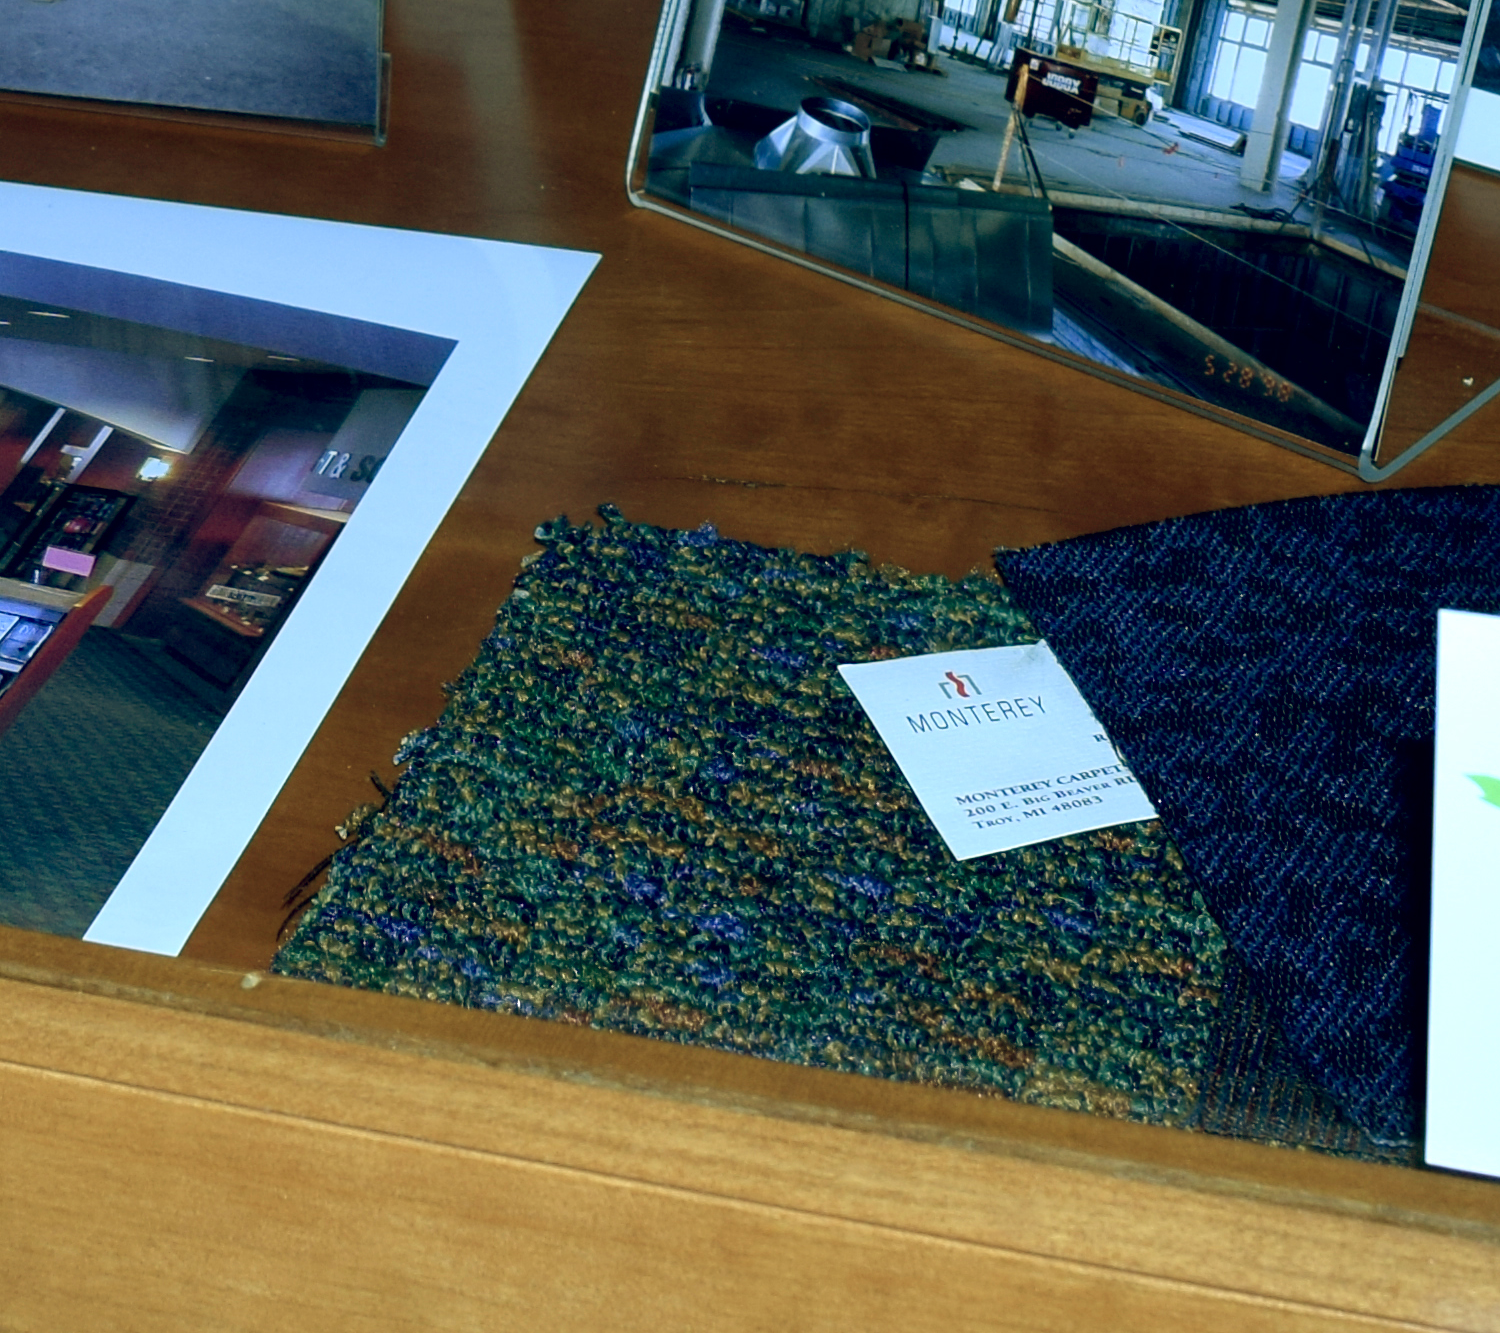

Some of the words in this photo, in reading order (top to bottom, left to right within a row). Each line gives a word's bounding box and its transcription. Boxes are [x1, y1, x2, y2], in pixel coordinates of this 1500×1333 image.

[905, 694, 1048, 735] MONTEREY
[955, 778, 1053, 807] MONTEREY
[964, 803, 997, 819] 200
[1022, 806, 1048, 820] MI
[1051, 794, 1104, 813] 48083
